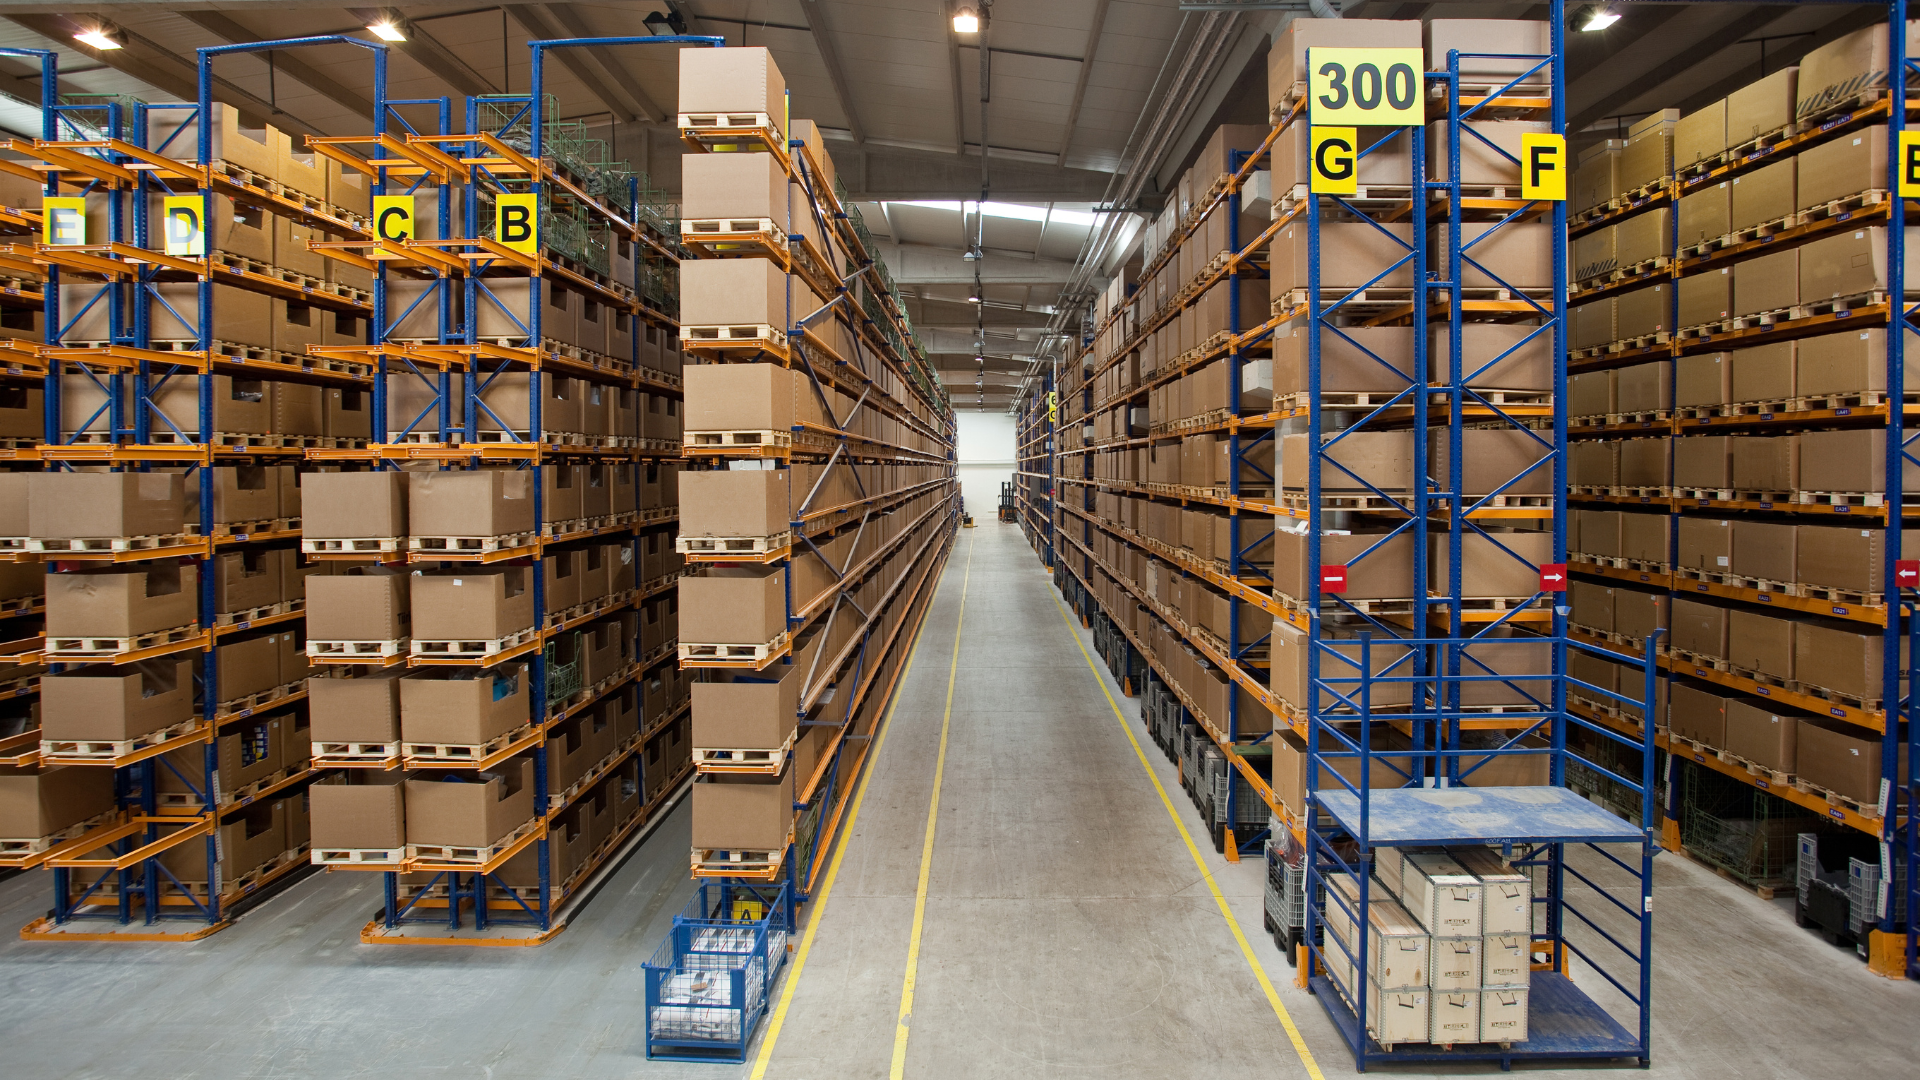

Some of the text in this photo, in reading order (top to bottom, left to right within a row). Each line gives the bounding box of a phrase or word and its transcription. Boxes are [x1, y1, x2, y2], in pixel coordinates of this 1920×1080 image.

[1318, 62, 1416, 110] 300
[1315, 138, 1354, 180] G
[1530, 146, 1558, 188] F
[50, 208, 78, 244] E
[169, 207, 199, 244] D
[378, 206, 409, 243] C
[502, 205, 532, 242] B
[1832, 708, 1844, 716] EA11
[1830, 809, 1842, 818] EA01
[740, 909, 752, 924] A
